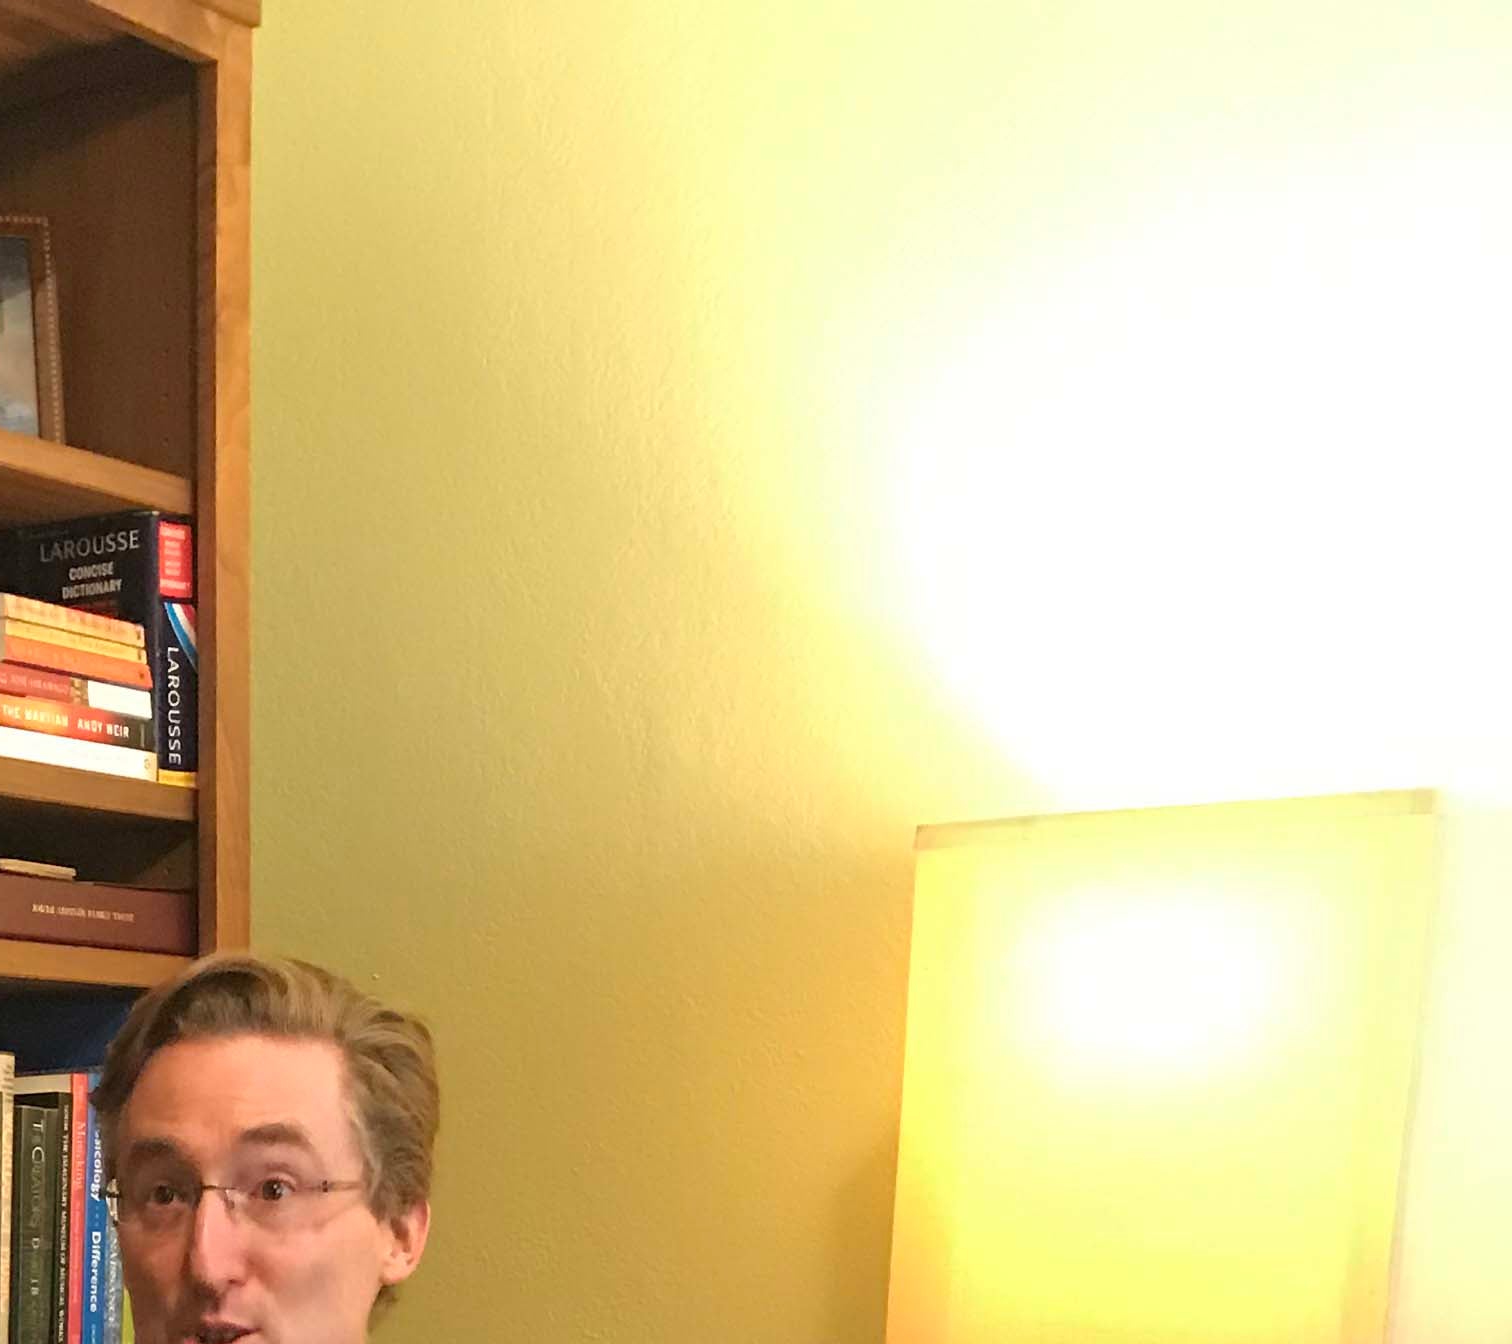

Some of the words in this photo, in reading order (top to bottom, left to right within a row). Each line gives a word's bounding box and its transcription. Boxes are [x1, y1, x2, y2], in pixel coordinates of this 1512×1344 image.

[40, 529, 140, 562] LAROUSSE
[69, 561, 114, 581] CONCISE
[62, 578, 122, 600] DICTIONARY
[2, 704, 20, 720] THE
[24, 710, 69, 728] MARTIAN
[77, 717, 103, 733] ANDY
[106, 724, 130, 738] WEIR
[167, 646, 182, 766] LAROUSSE
[88, 1231, 102, 1313] Difference
